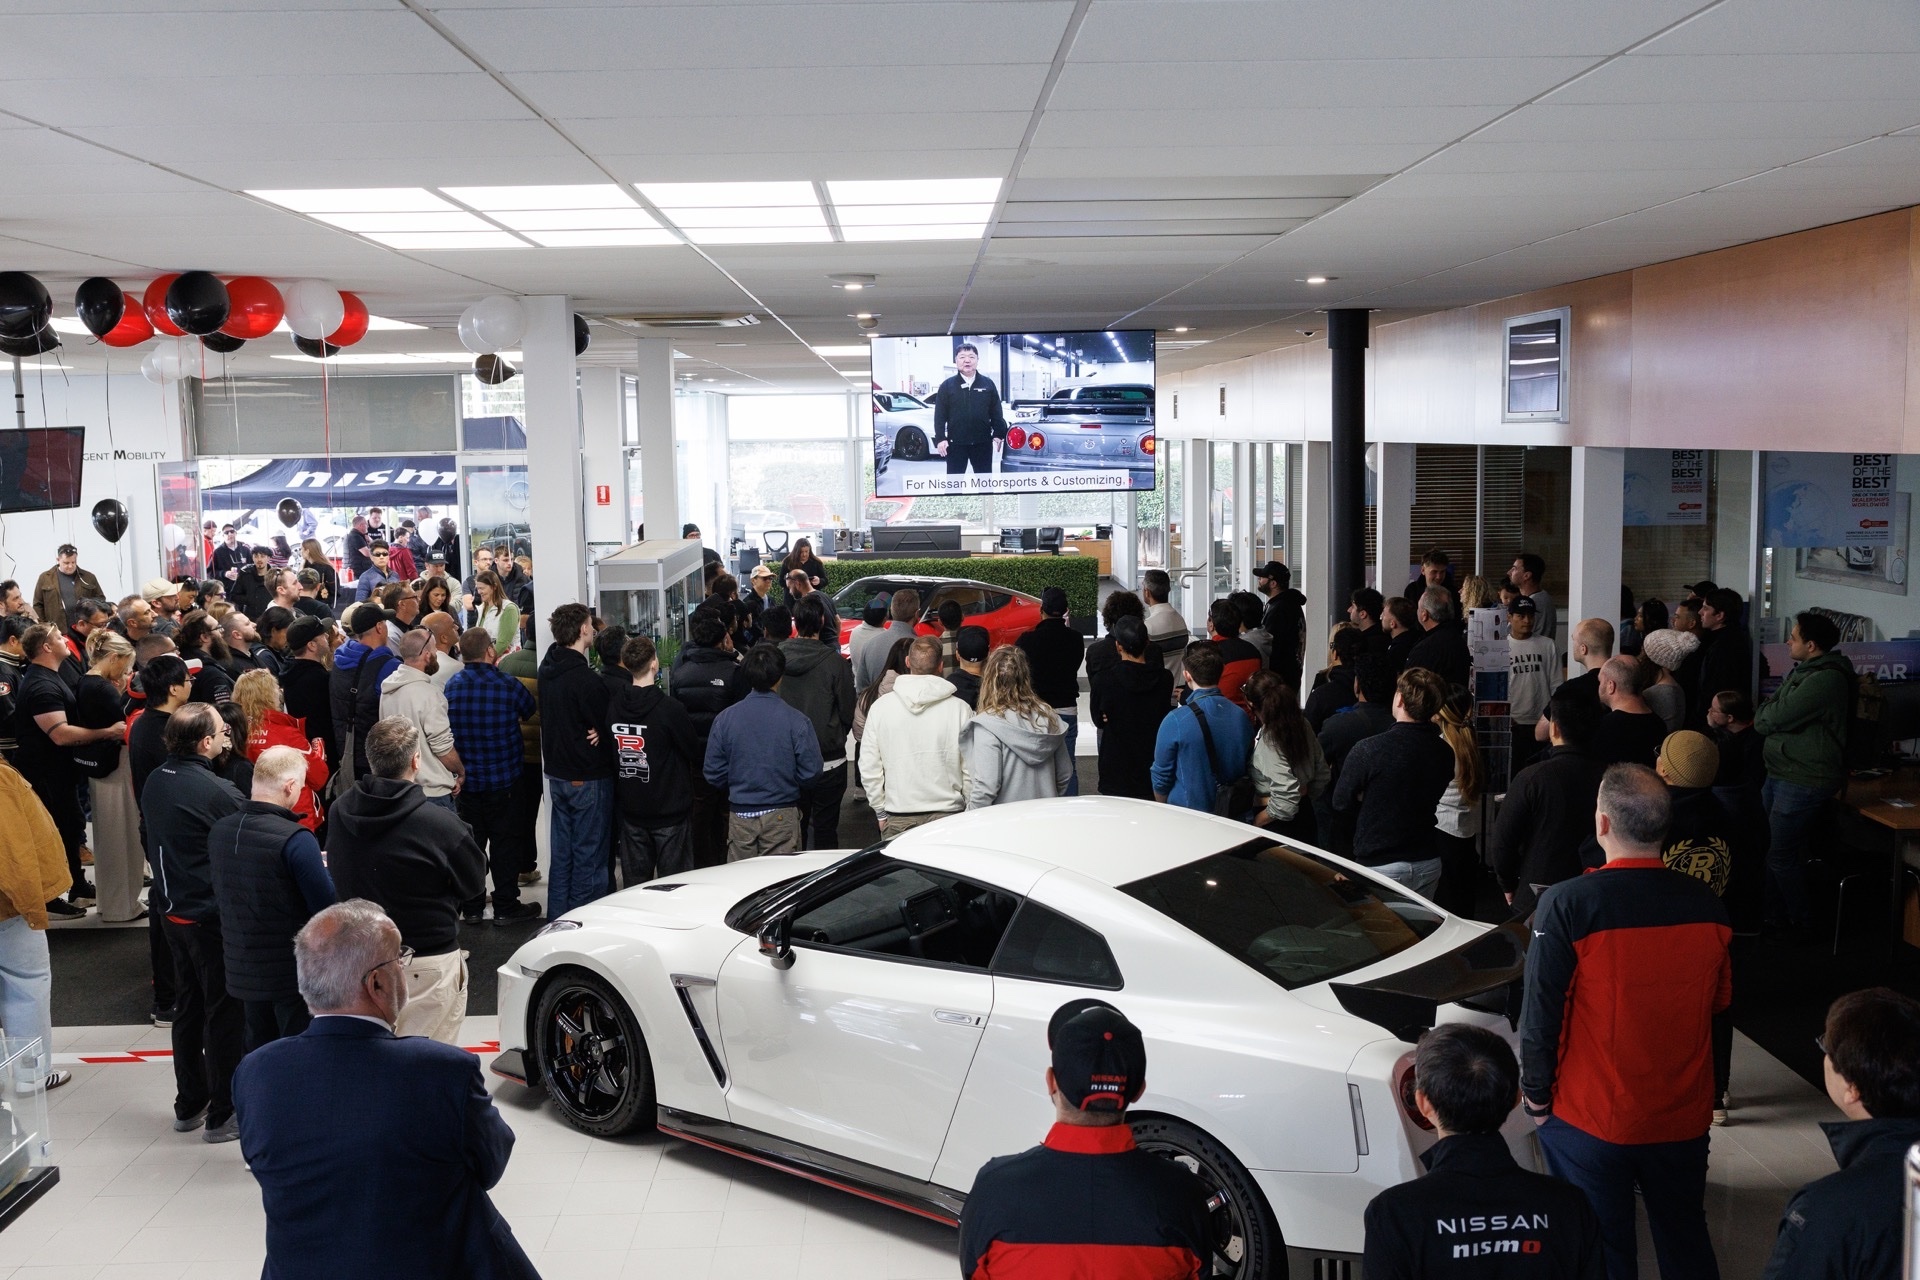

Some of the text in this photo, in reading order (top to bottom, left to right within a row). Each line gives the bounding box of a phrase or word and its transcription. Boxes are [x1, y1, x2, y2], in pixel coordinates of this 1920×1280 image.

[113, 450, 166, 460] MOBILITY
[1672, 450, 1703, 460] BEST
[1853, 454, 1891, 466] BEST
[1672, 460, 1703, 468] OF THE
[1671, 468, 1703, 478] BEST
[1853, 467, 1891, 476] OF THE
[285, 468, 457, 488] nism
[906, 478, 924, 490] For
[928, 478, 967, 489] Nissan
[970, 476, 1037, 489] Motorsports
[1041, 477, 1049, 487] &
[1852, 477, 1890, 488] BEST
[611, 723, 648, 735] GT
[614, 734, 645, 752] R
[1091, 1074, 1127, 1083] NISSAN
[1091, 1083, 1126, 1092] nismo
[1437, 1214, 1549, 1235] NISSAN
[1453, 1240, 1542, 1259] nismo
